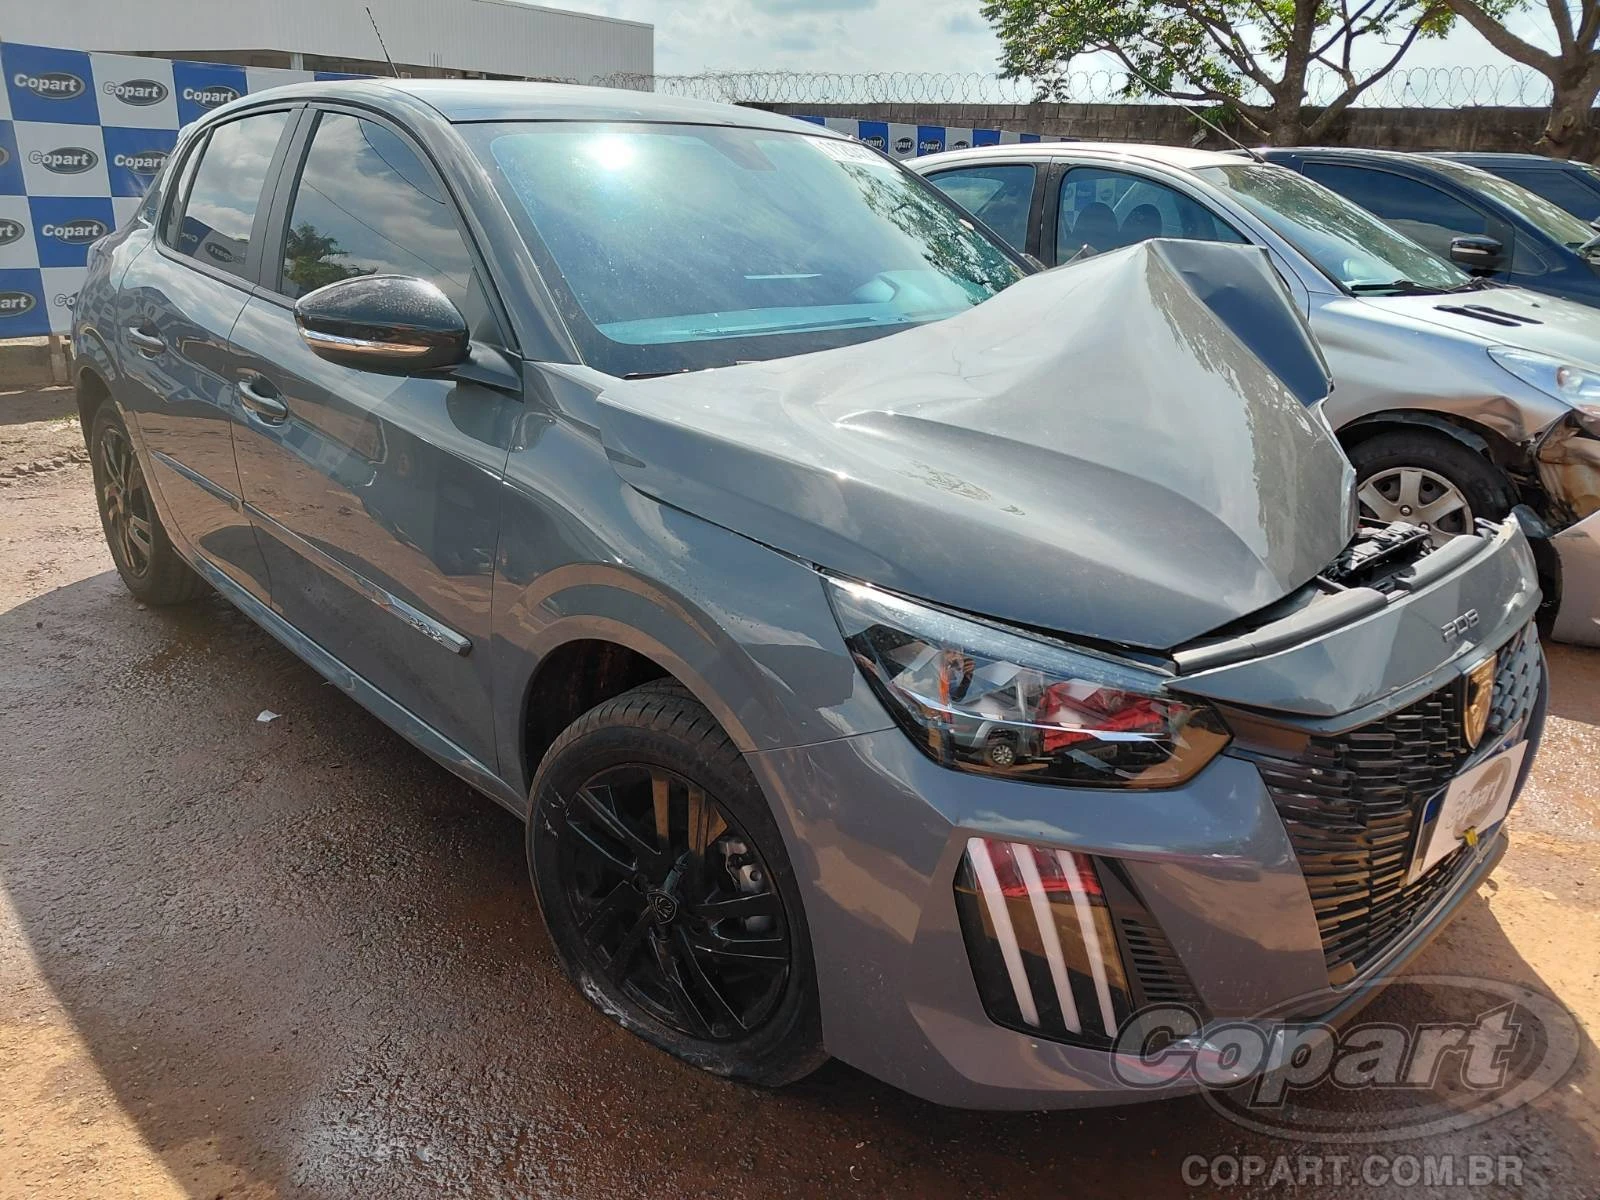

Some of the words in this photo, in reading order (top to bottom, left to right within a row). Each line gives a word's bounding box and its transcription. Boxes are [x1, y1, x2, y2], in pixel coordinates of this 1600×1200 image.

[14, 74, 77, 92] Copart
[103, 82, 158, 100] Copart
[183, 88, 233, 104] Copart
[919, 141, 940, 151] Copart
[29, 151, 89, 168] Copart
[42, 224, 99, 241] Copart
[0, 297, 27, 309] art
[1441, 609, 1480, 642] 208
